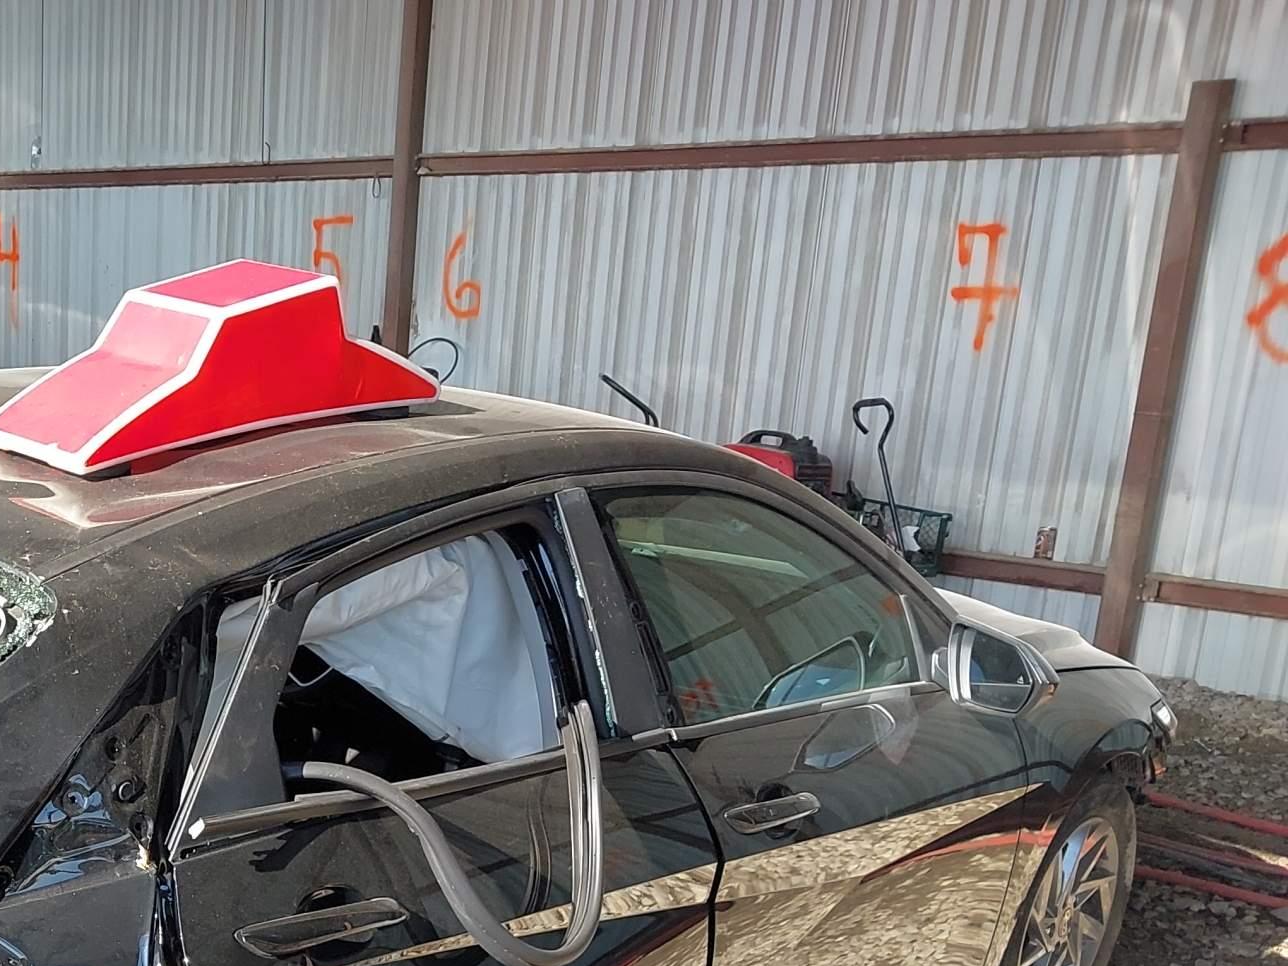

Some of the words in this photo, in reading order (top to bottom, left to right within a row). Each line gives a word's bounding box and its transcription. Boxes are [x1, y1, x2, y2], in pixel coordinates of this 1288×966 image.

[313, 215, 354, 282] 5
[443, 224, 481, 319] 6
[951, 222, 1020, 351] 7
